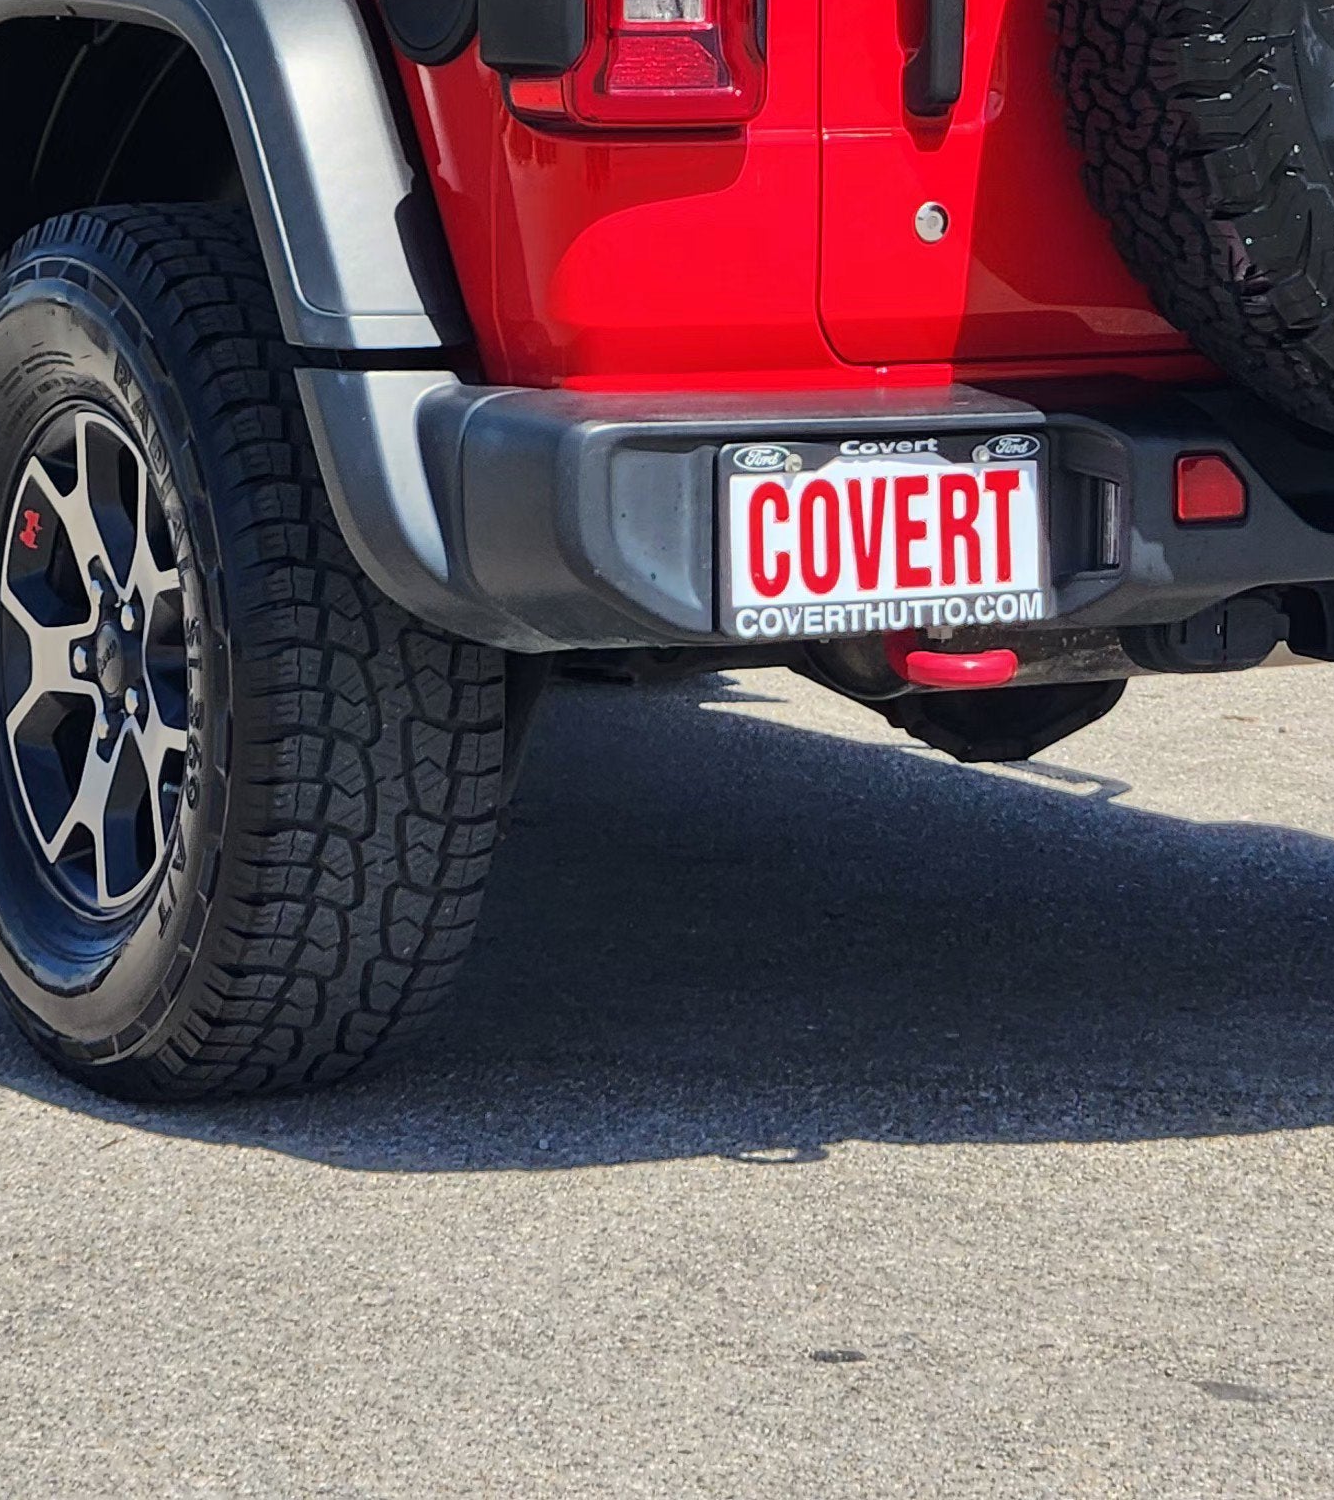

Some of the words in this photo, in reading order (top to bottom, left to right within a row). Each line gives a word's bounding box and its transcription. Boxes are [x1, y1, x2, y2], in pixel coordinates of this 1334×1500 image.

[840, 438, 939, 456] Covert
[995, 436, 1030, 455] Ford
[745, 448, 781, 467] Ford
[748, 468, 1021, 598] COVERT
[735, 592, 1045, 640] COVERTHUTTO.COM
